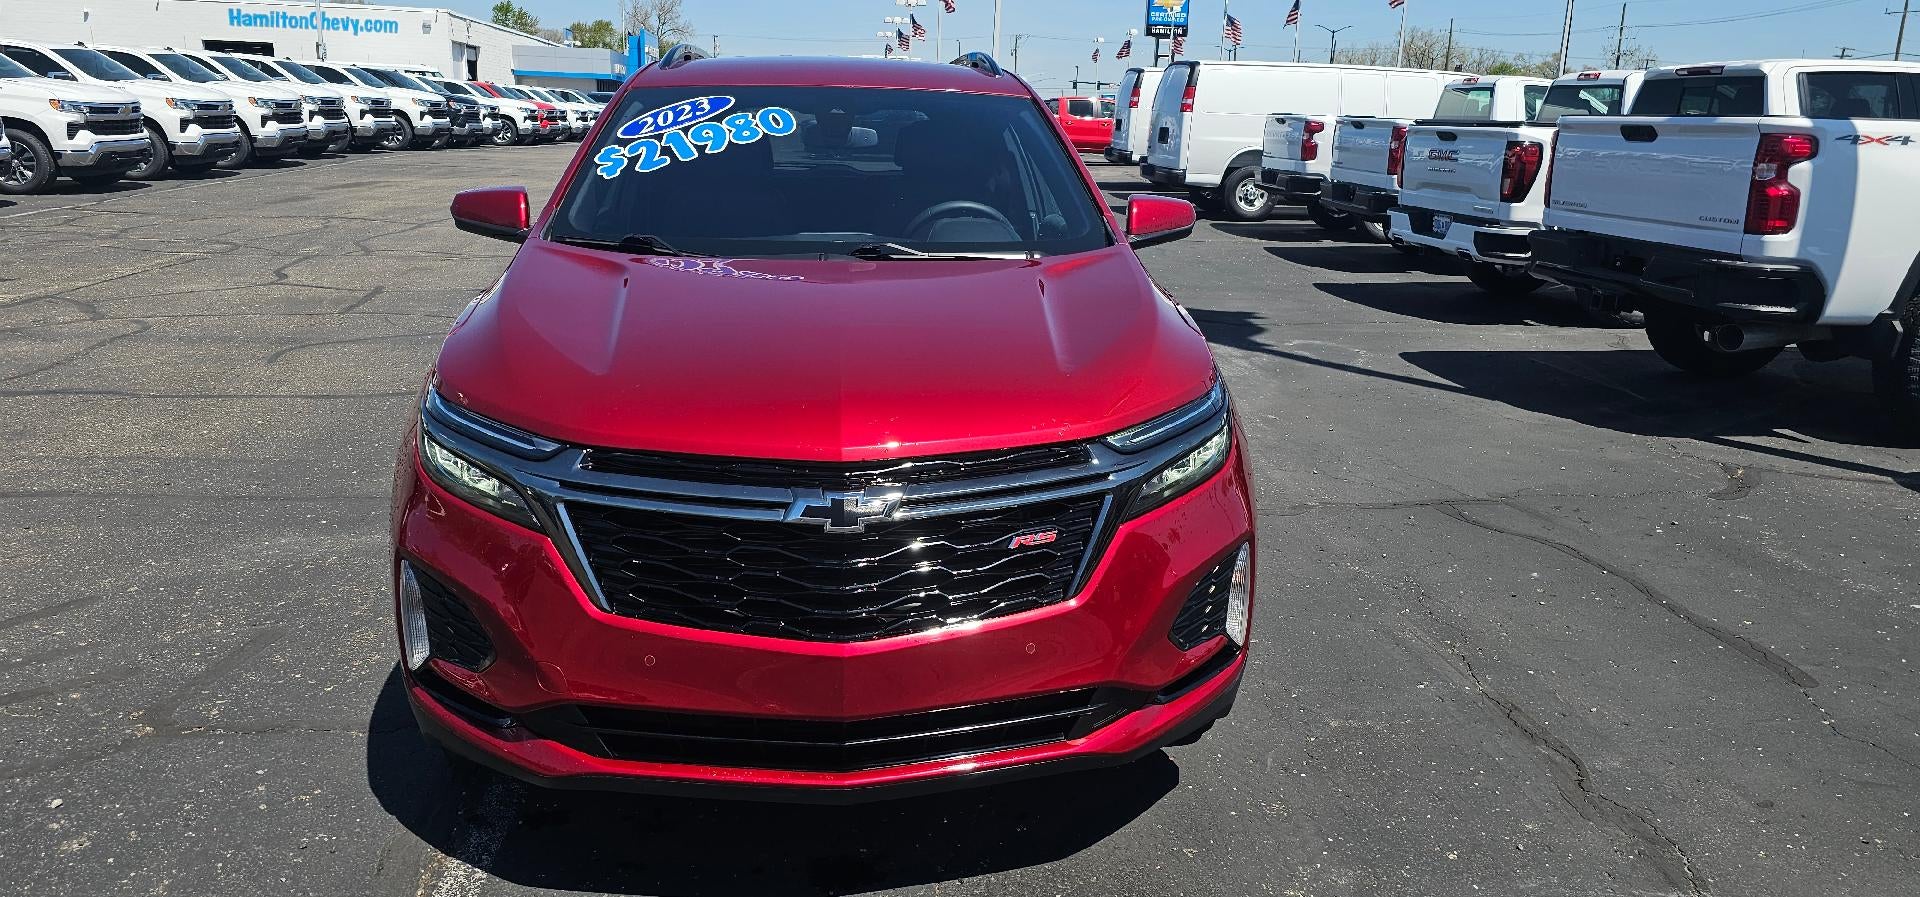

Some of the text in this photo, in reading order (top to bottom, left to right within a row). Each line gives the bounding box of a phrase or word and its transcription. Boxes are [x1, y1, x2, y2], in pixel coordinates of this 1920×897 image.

[228, 8, 399, 36] HamiltonChevy.com
[1151, 27, 1183, 35] HAMILON
[638, 98, 711, 135] 2023
[594, 107, 797, 179] $21980
[1428, 148, 1461, 162] GMC
[1698, 215, 1740, 225] CUSTOM
[1008, 530, 1058, 549] RS
